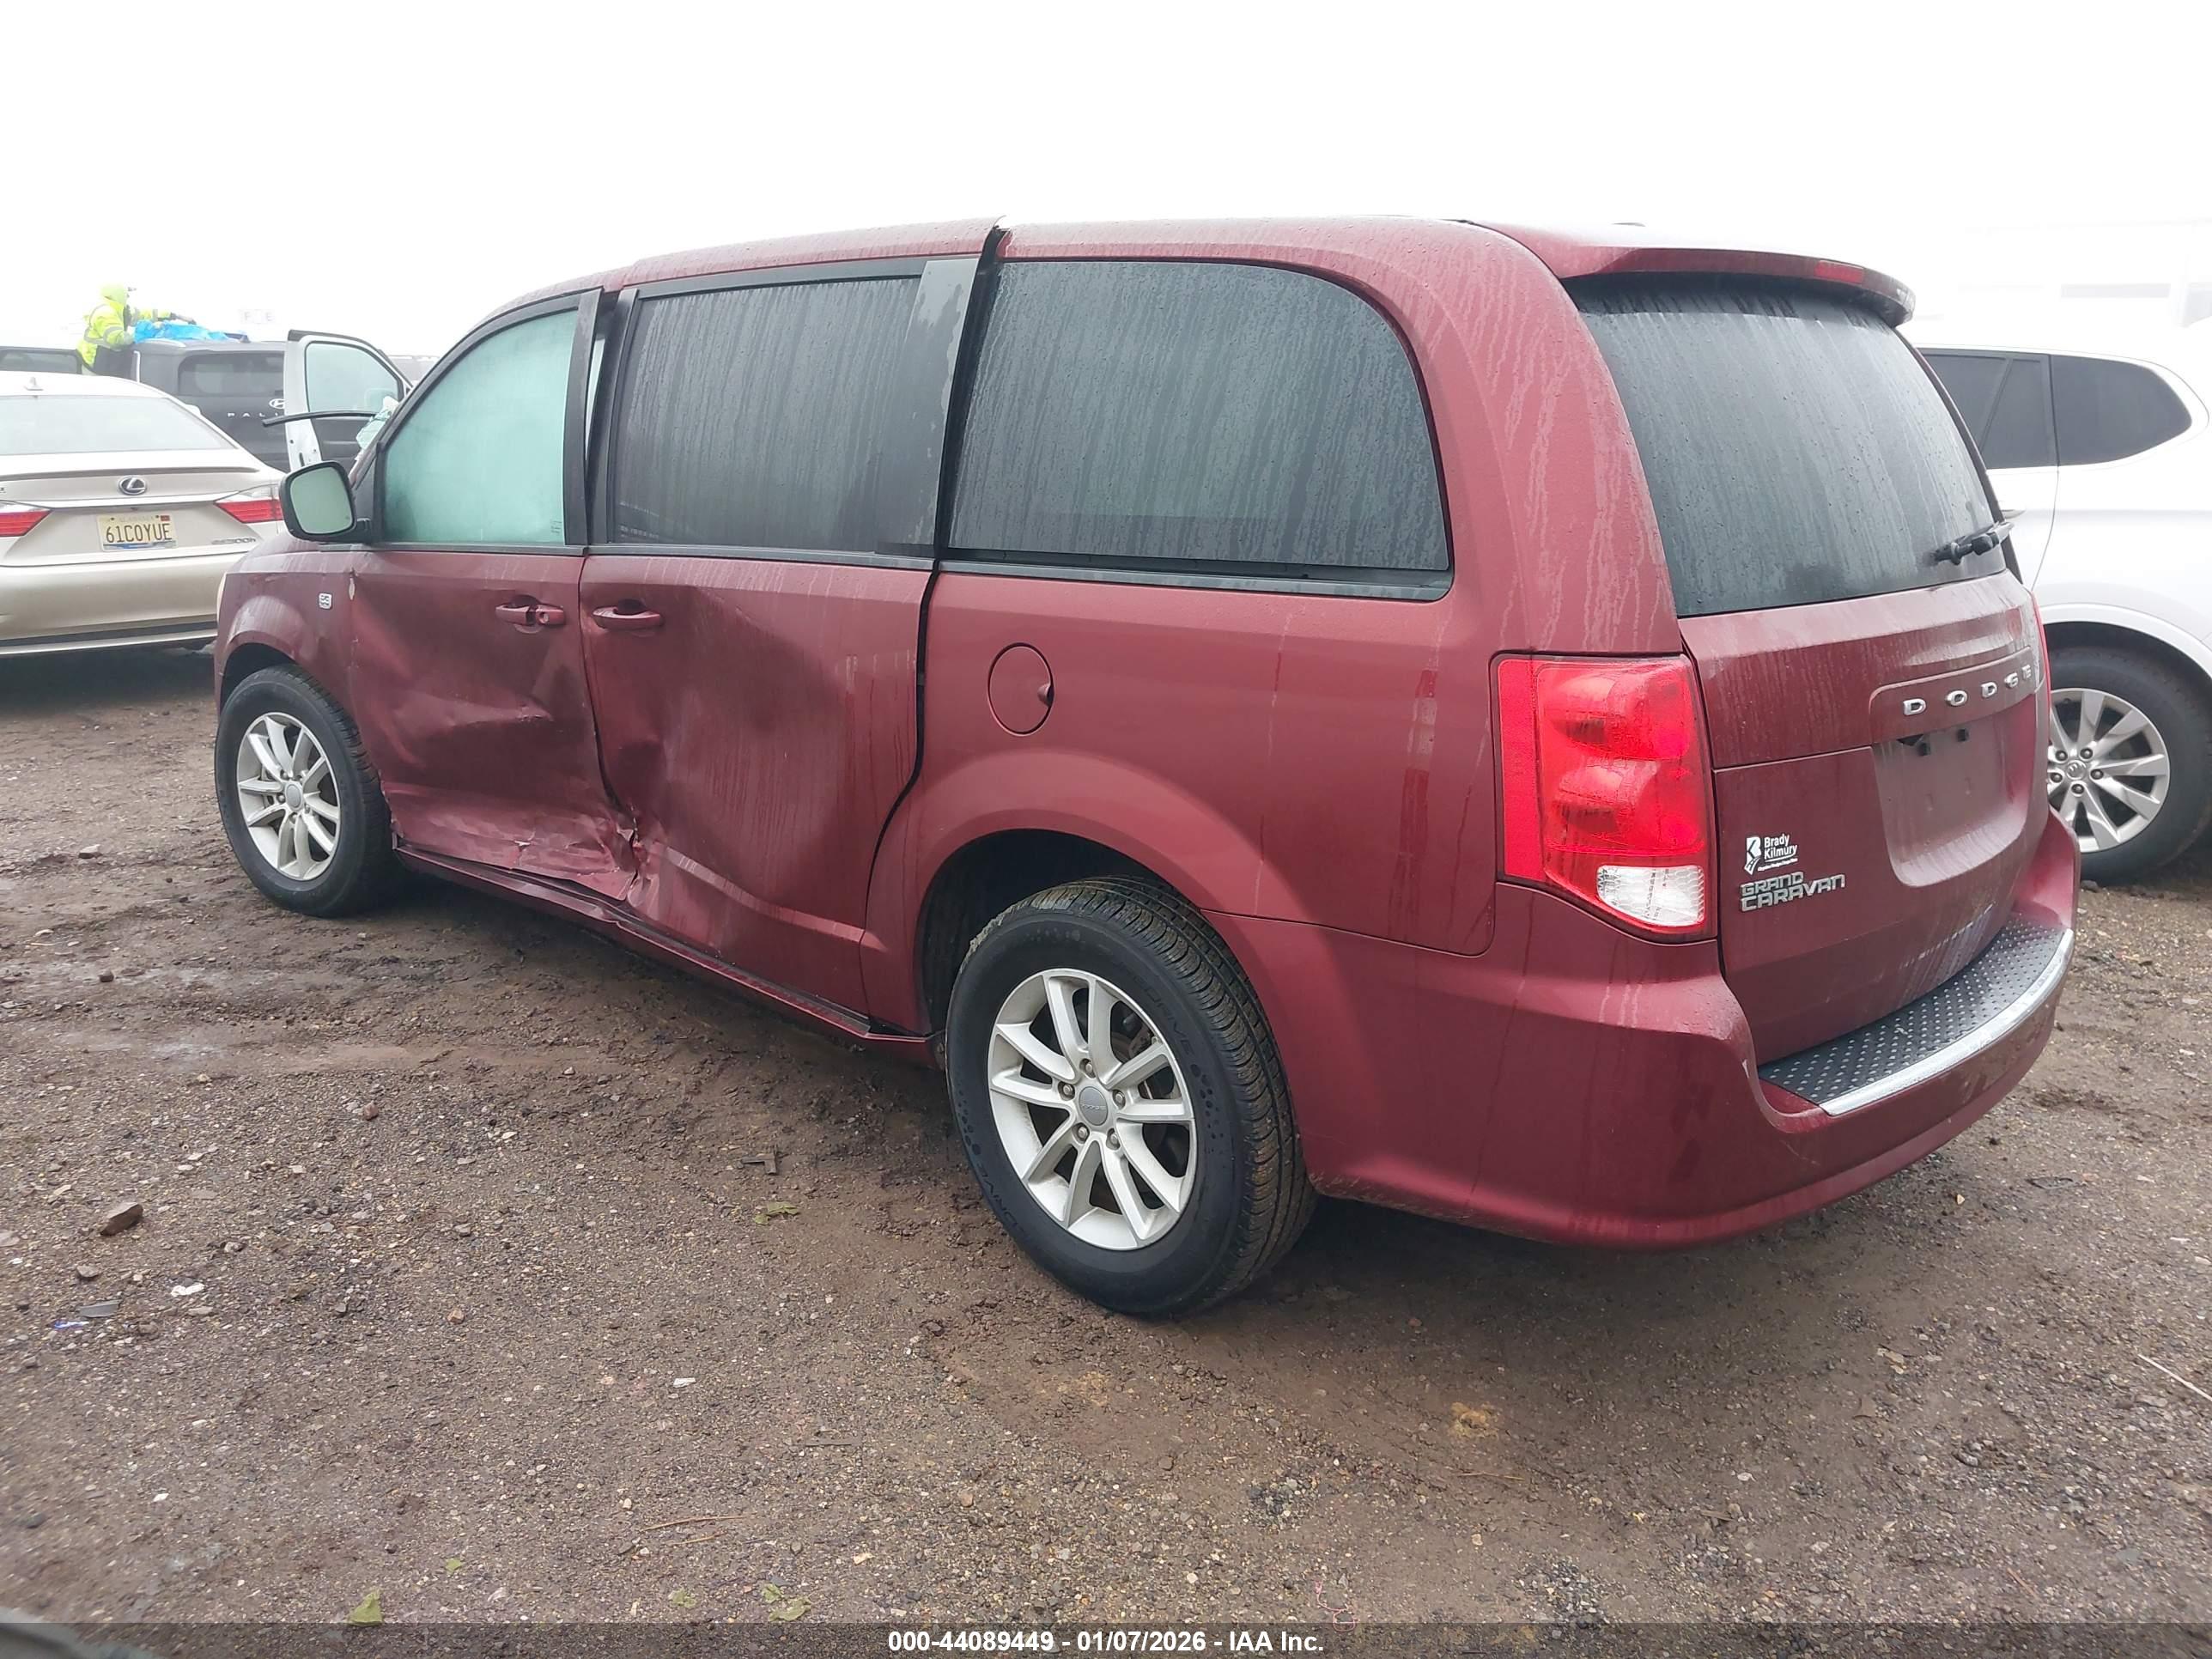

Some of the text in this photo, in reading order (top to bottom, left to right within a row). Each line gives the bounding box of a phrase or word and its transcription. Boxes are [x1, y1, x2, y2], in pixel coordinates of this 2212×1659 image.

[1902, 664, 2032, 716] DODGE
[1764, 833, 1790, 848] Brady
[1764, 844, 1798, 860] Kilmury
[1740, 871, 1804, 896] GRAND
[1740, 874, 1845, 912] CARAVAN
